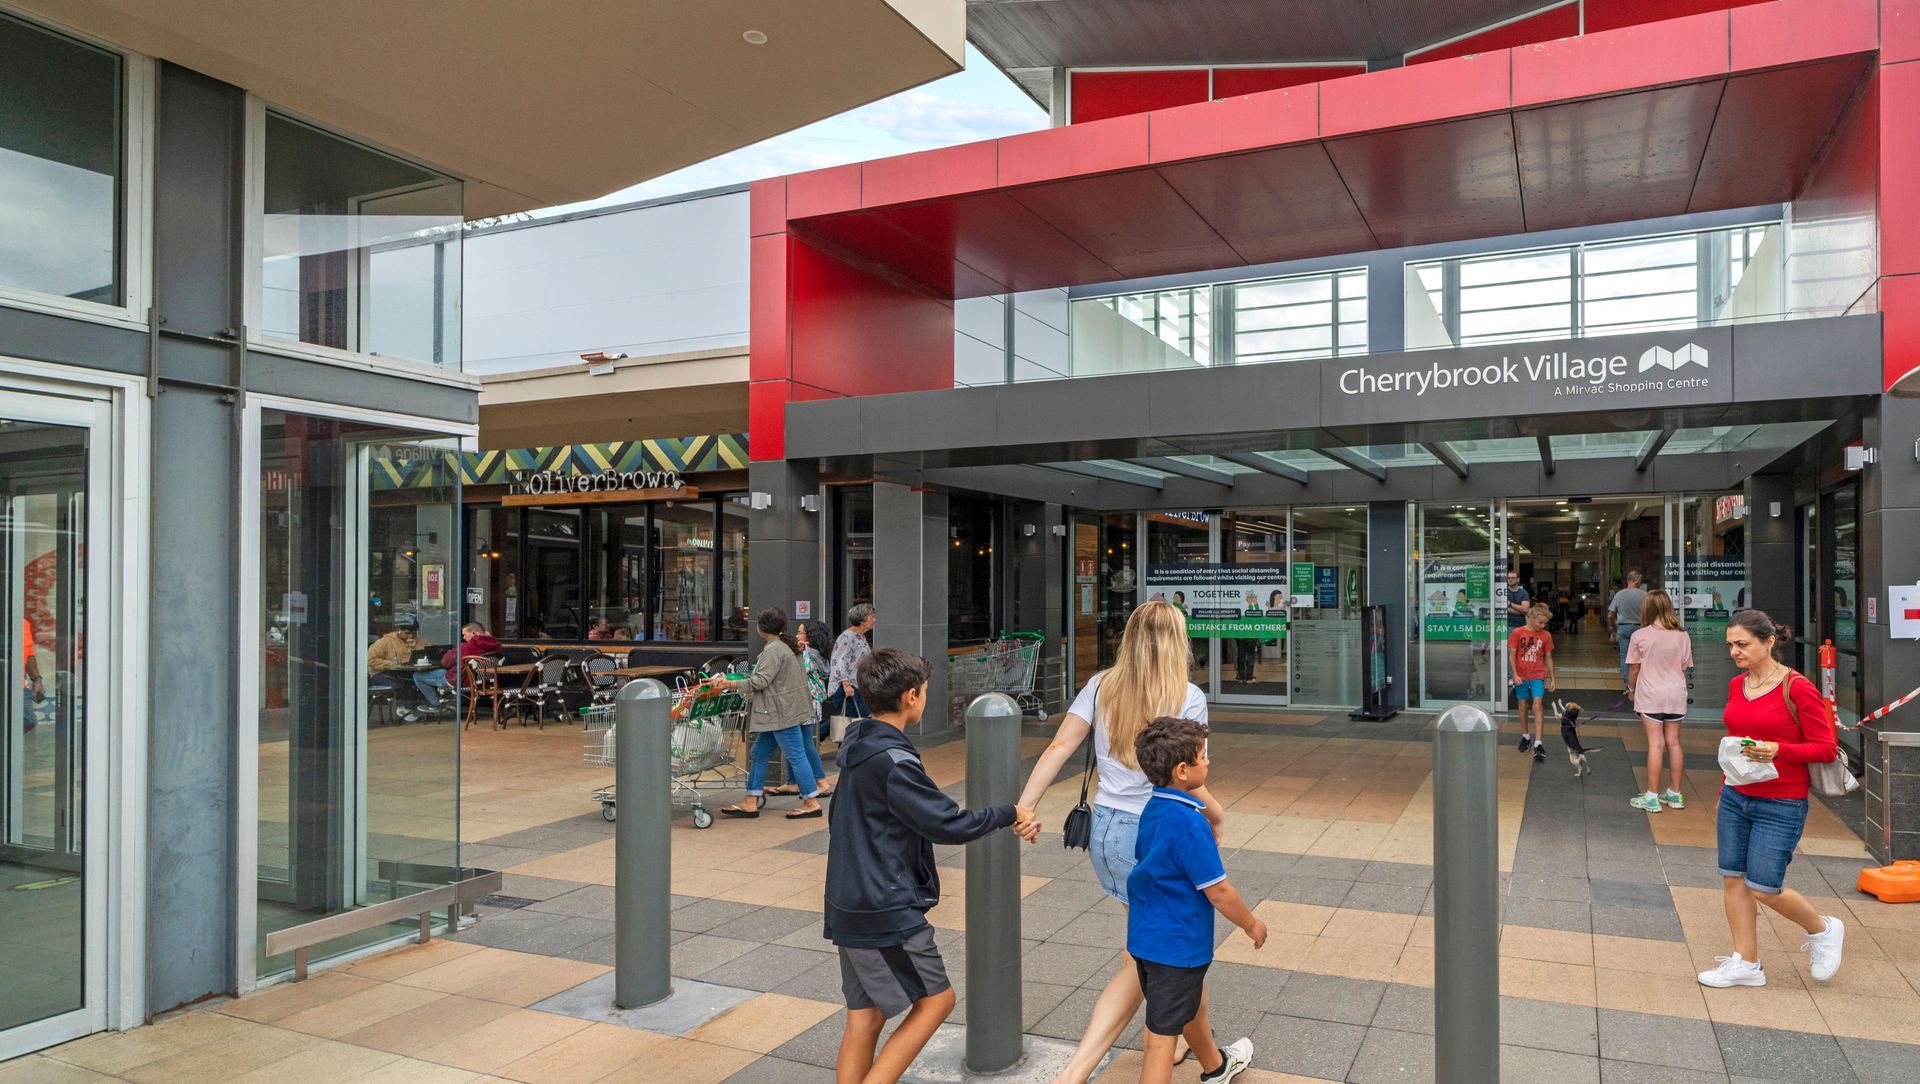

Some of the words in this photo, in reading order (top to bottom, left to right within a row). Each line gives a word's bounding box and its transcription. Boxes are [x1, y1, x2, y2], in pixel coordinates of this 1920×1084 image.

[1340, 357, 1519, 397] Cherrybrook
[1524, 352, 1627, 384] Village
[1554, 387, 1562, 396] A
[1566, 385, 1604, 395] Mirvac
[1608, 380, 1663, 393] Shopping
[1667, 377, 1709, 389] Centre
[530, 469, 676, 495] OliverBrown
[1691, 569, 1719, 577] visiting
[468, 593, 482, 602] OPEN
[1193, 590, 1241, 598] TOGETHER
[1189, 623, 1227, 631] DISTANCE
[1229, 623, 1253, 631] FROM
[1254, 623, 1286, 631] OTHERS
[1520, 636, 1543, 650] GAP
